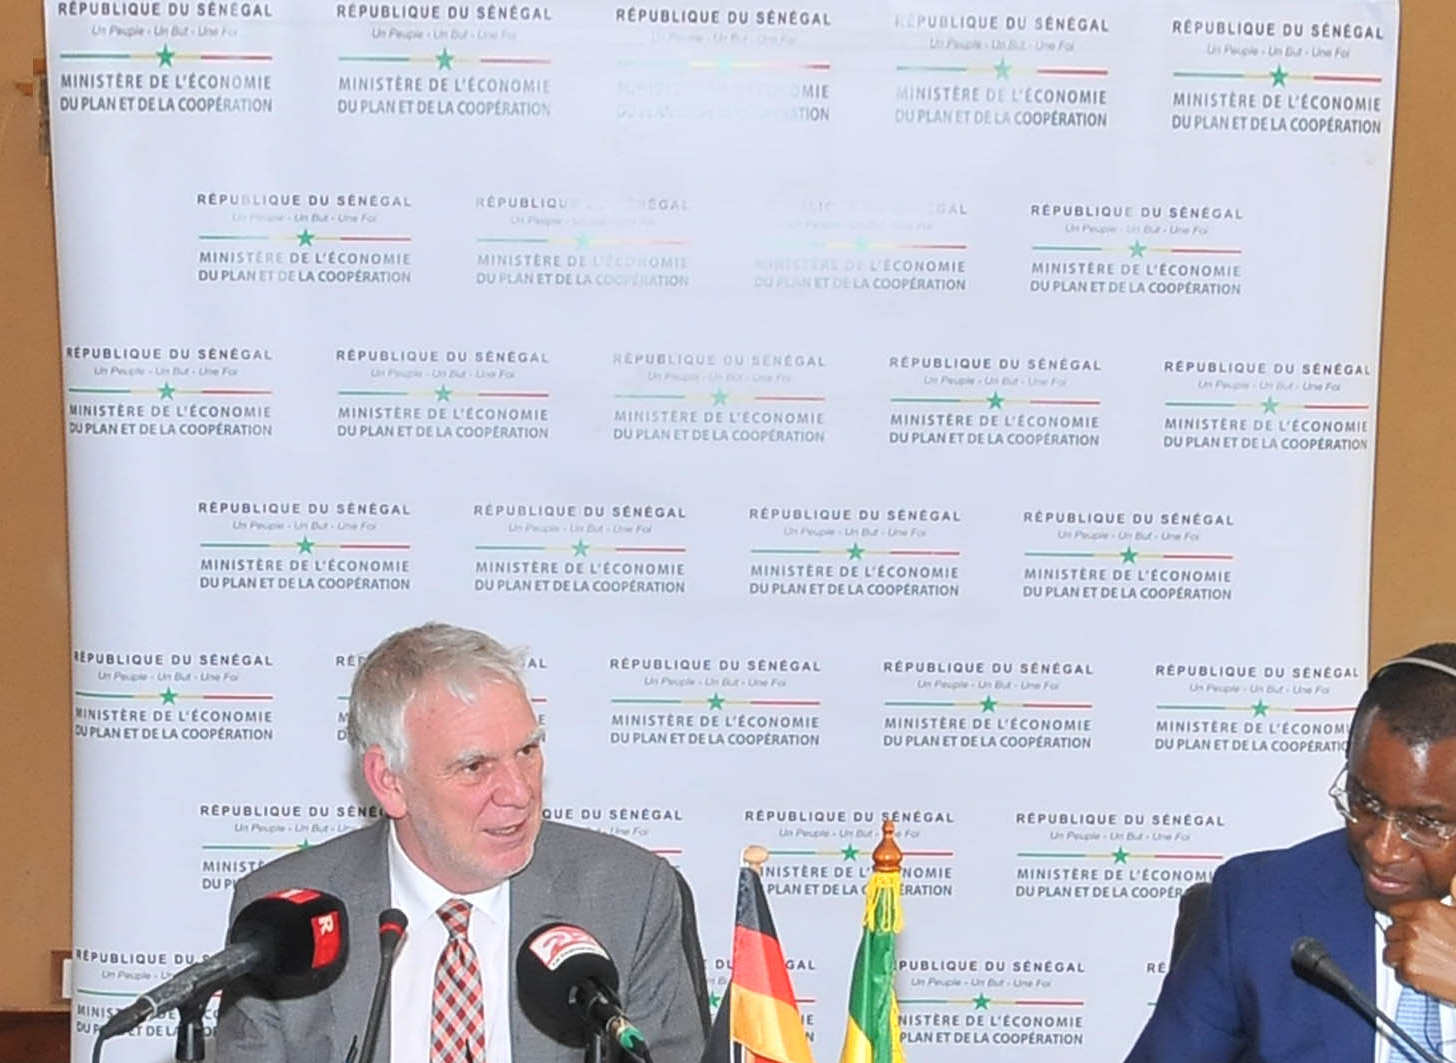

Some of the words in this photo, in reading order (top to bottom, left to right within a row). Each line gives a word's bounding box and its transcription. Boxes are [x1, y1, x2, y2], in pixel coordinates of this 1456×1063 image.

[58, 0, 160, 17] RÉPUBLIQUE
[169, 3, 189, 16] DU
[198, 1, 272, 17] SÉNÉGAL
[337, 3, 440, 20] RÉPUBLIQUE
[448, 6, 469, 20] DU
[478, 4, 551, 20] SÉNÉGAL
[616, 7, 720, 24] RÉPUBLIQUE
[727, 11, 749, 25] DU
[756, 10, 831, 26] SÉNÉGAL
[1173, 19, 1275, 37] RÉPUBLIQUE
[1283, 24, 1303, 37] DU
[1312, 22, 1385, 39] SÉNÉGAL
[59, 72, 143, 89] MINISTÈRE
[150, 75, 169, 89] DE
[176, 72, 271, 90] L'ÉCONOMIE
[339, 75, 422, 92] MINISTÈRE
[429, 79, 448, 92] DE
[1173, 91, 1256, 109] MINISTÈRE
[1263, 95, 1281, 109] DE
[1288, 93, 1382, 111] L'ÉCONOMIE
[1173, 115, 1192, 129] DU
[1195, 115, 1229, 130] PLAN
[1233, 116, 1247, 130] ET
[1251, 117, 1267, 131] DE
[1271, 117, 1286, 131] LA
[1290, 115, 1382, 134] COOPÉRATION
[198, 193, 300, 206] RÉPUBLIQUE
[309, 195, 329, 206] DU
[338, 194, 411, 207] SÉNÉGAL
[1031, 204, 1133, 218] RÉPUBLIQUE
[1141, 207, 1161, 218] DU
[1170, 206, 1243, 219] SÉNÉGAL
[1032, 261, 1114, 275] MINISTÈRE
[1121, 264, 1140, 275] DE
[1147, 262, 1241, 277] L'ÉCONOMIE
[170, 349, 190, 360] DU
[199, 347, 272, 360] SÉNÉGAL
[336, 349, 438, 362] RÉPUBLIQUE
[447, 352, 467, 362] DU
[476, 350, 549, 363] SÉNÉGAL
[890, 356, 991, 369] RÉPUBLIQUE
[1000, 359, 1020, 370] DU
[1028, 358, 1101, 370] SÉNÉGAL
[1165, 360, 1266, 374] RÉPUBLIQUE
[1274, 364, 1294, 374] DU
[1302, 362, 1371, 375] SÉNÉGAL
[151, 406, 170, 417] DE
[177, 404, 271, 417] L'ÉCONOMIE
[338, 406, 421, 419] MINISTÈRE
[428, 409, 446, 419] DE
[454, 407, 548, 420] L'ÉCONOMIE
[890, 413, 973, 426] MINISTÈRE
[980, 416, 998, 427] DE
[1005, 414, 1099, 428] L'ÉCONOMIE
[1165, 417, 1247, 431] MINISTÈRE
[1254, 420, 1272, 431] DE
[1279, 418, 1368, 433] L'ÉCONOMIE
[890, 432, 909, 443] DU
[912, 432, 946, 443] PLAN
[950, 433, 964, 444] ET
[968, 433, 984, 444] DE
[988, 433, 1003, 444] LA
[1007, 432, 1099, 446] COOPÉRATION
[199, 501, 300, 514] RÉPUBLIQUE
[309, 504, 329, 514] DU
[337, 502, 410, 515] SÉNÉGAL
[474, 504, 576, 517] RÉPUBLIQUE
[584, 506, 604, 517] DU
[613, 505, 686, 518] SÉNÉGAL
[750, 507, 851, 521] RÉPUBLIQUE
[859, 510, 879, 521] DU
[888, 509, 961, 521] SÉNÉGAL
[1024, 511, 1125, 524] RÉPUBLIQUE
[1133, 514, 1153, 524] DU
[1161, 513, 1234, 525] SÉNÉGAL
[201, 558, 283, 571] MINISTÈRE
[290, 561, 308, 571] DE
[316, 558, 410, 572] L'ÉCONOMIE
[476, 560, 558, 574] MINISTÈRE
[565, 563, 584, 574] DE
[591, 561, 685, 575] L'ÉCONOMIE
[751, 564, 833, 577] MINISTÈRE
[840, 567, 858, 577] DE
[865, 565, 959, 578] L'ÉCONOMIE
[1024, 567, 1106, 581] MINISTÈRE
[1113, 570, 1131, 581] DE
[1138, 568, 1232, 582] L'ÉCONOMIE
[201, 577, 220, 588] DU
[223, 577, 257, 588] PLAN
[261, 578, 274, 588] ET
[279, 578, 295, 589] DE
[299, 578, 314, 589] LA
[318, 576, 410, 589] COOPÉRATION
[172, 655, 192, 665] DU
[200, 653, 272, 666] SÉNÉGAL
[610, 657, 711, 671] RÉPUBLIQUE
[720, 660, 740, 671] DU
[748, 659, 821, 671] SÉNÉGAL
[884, 660, 985, 674] RÉPUBLIQUE
[993, 663, 1013, 674] DU
[1021, 662, 1093, 674] SÉNÉGAL
[1156, 664, 1256, 678] RÉPUBLIQUE
[1264, 667, 1284, 678] DU
[1292, 666, 1359, 679] SÉNÉGAL
[154, 711, 172, 721] DE
[179, 709, 272, 722] L'ÉCONOMIE
[611, 714, 694, 727] MINISTÈRE
[700, 716, 719, 727] DE
[726, 714, 819, 728] L'ÉCONOMIE
[884, 716, 966, 730] MINISTÈRE
[973, 719, 991, 730] DE
[998, 717, 1091, 731] L'ÉCONOMIE
[884, 735, 903, 746] DU
[906, 735, 940, 746] PLAN
[943, 736, 957, 747] ET
[961, 736, 977, 747] DE
[981, 736, 996, 747] LA
[1000, 734, 1091, 748] COOPÉRATION
[1017, 812, 1117, 825] RÉPUBLIQUE
[1124, 815, 1144, 825] DU
[1153, 814, 1224, 826] SÉNÉGAL
